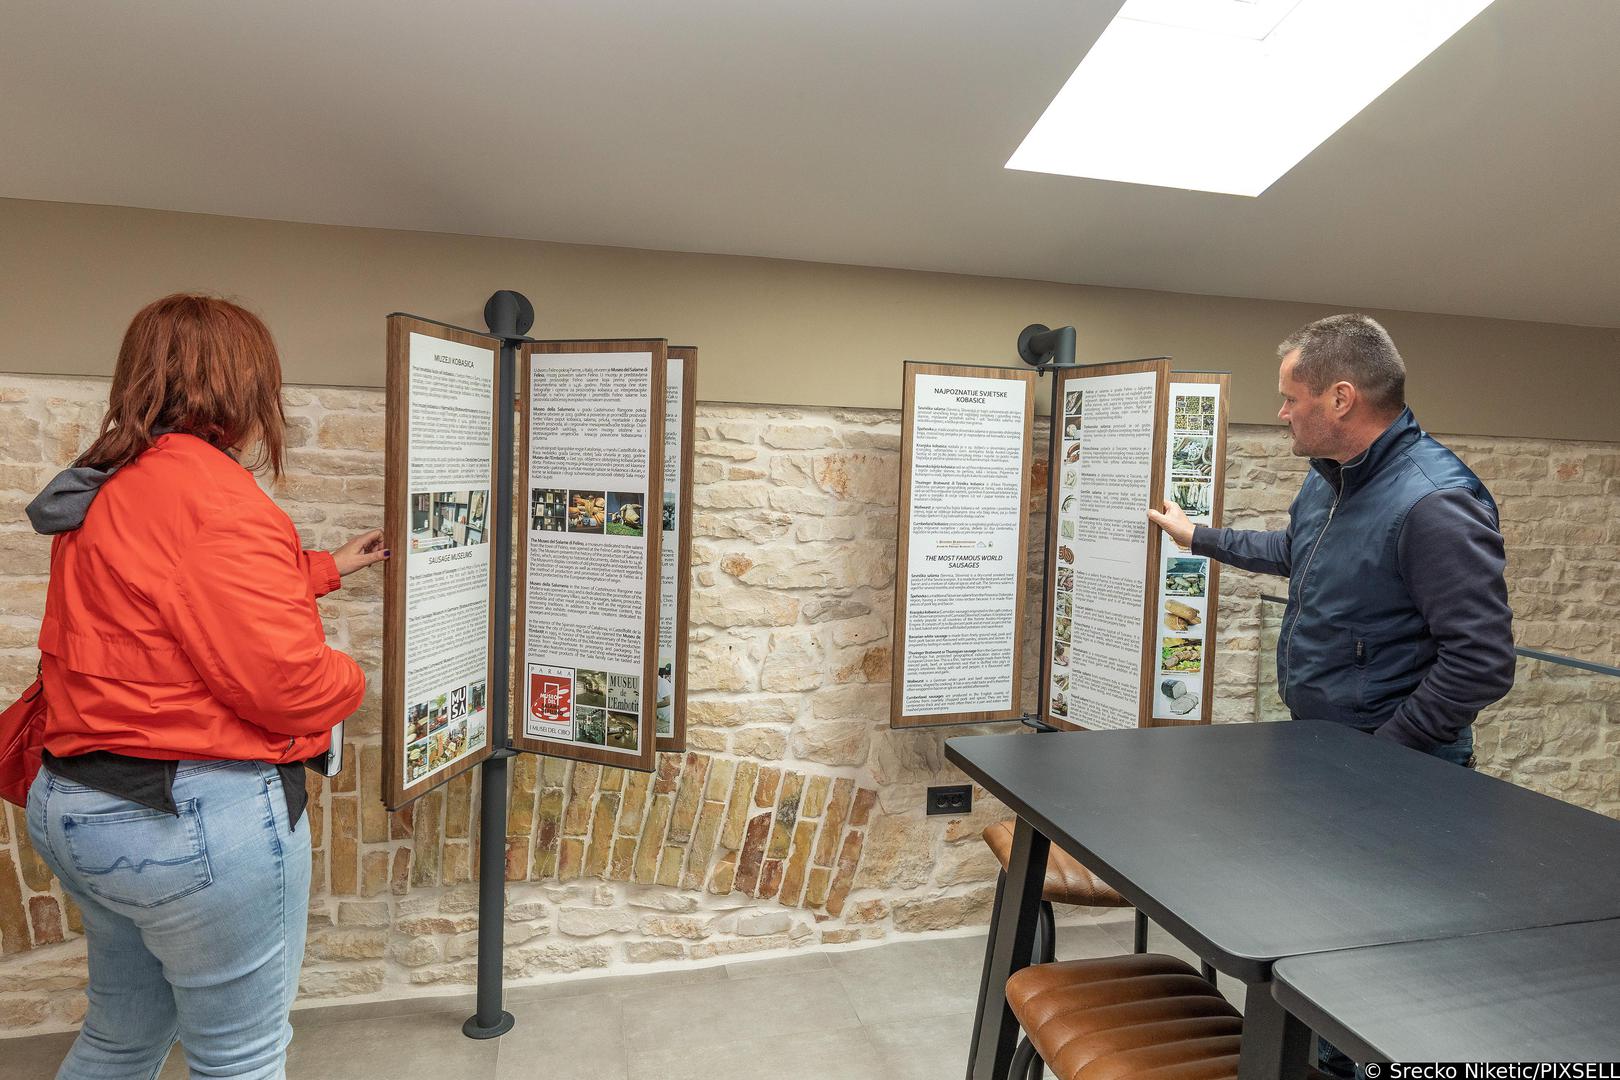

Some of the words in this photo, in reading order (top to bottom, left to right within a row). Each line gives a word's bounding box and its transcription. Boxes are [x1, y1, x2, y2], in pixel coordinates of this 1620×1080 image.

[934, 388, 978, 396] NAJPOZNATIJE
[429, 554, 450, 564] SAUSAGE
[610, 676, 638, 689] MUSEU
